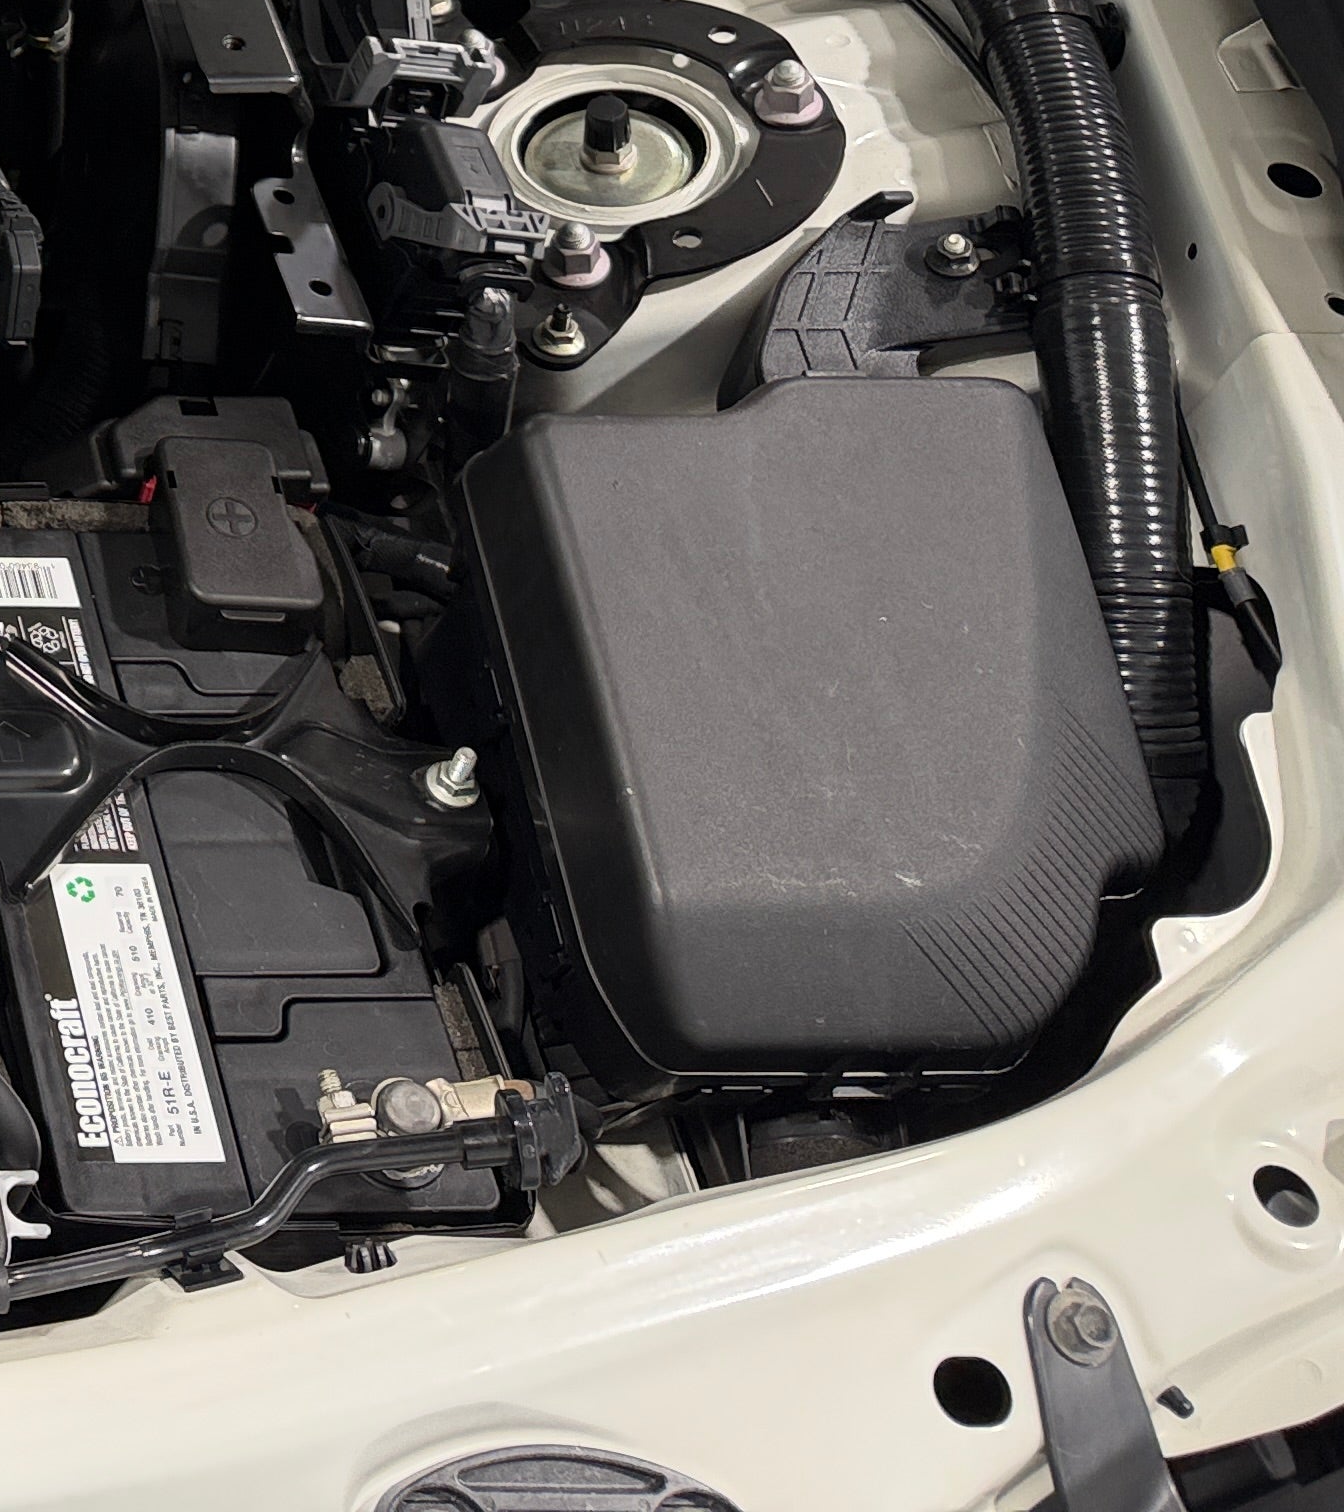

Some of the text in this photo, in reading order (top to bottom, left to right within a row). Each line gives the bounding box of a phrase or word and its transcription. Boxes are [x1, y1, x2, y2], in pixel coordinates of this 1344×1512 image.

[113, 885, 124, 897] 70
[143, 1006, 156, 1025] 410
[47, 998, 110, 1147] Econocraft
[156, 1070, 180, 1115] 51R-E
